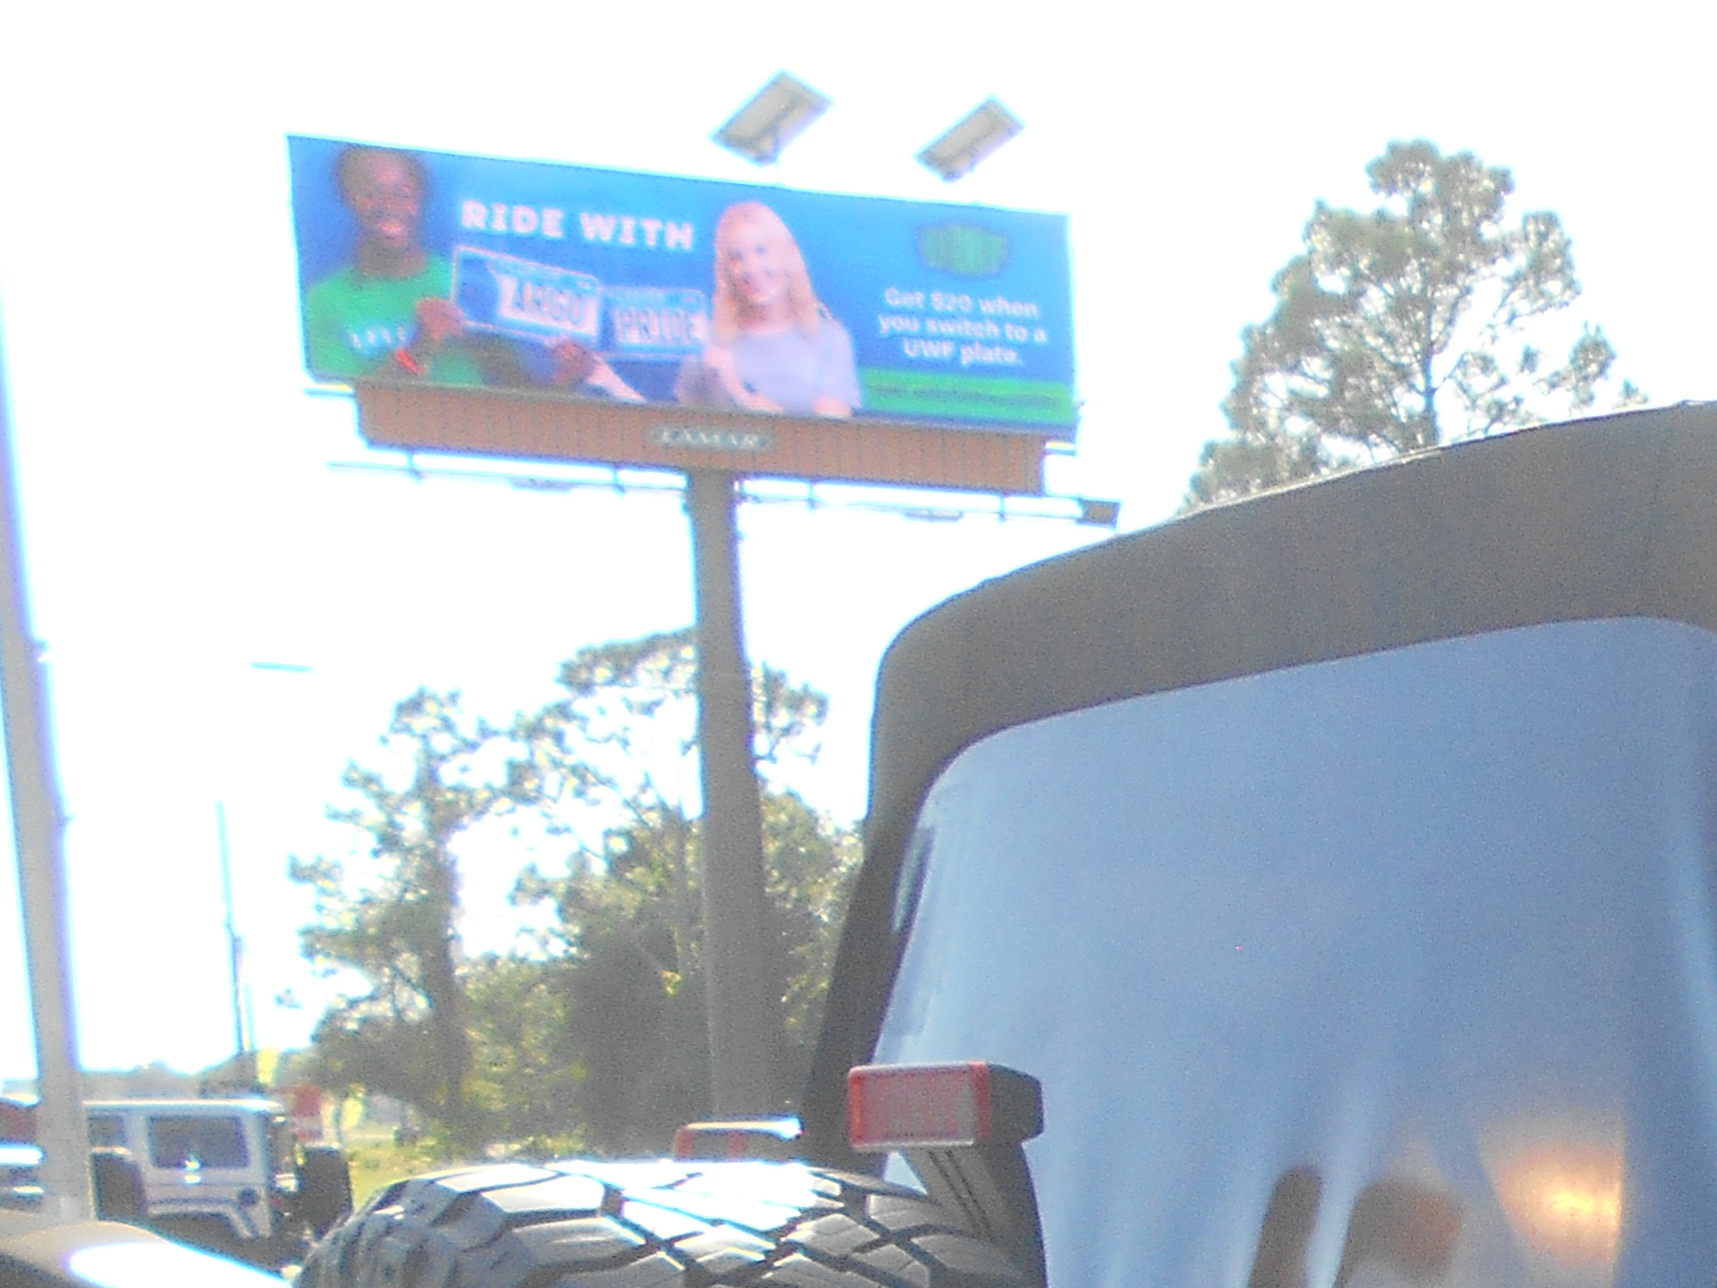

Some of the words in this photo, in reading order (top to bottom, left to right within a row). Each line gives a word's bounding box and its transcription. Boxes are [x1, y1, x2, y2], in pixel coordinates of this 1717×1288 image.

[462, 200, 563, 238] RIDE
[579, 212, 694, 250] WITH
[884, 287, 924, 309] Get
[930, 291, 972, 312] $20
[979, 296, 1039, 318] when
[879, 315, 919, 335] you
[927, 318, 999, 338] switch
[1005, 323, 1029, 342] to
[1034, 328, 1048, 343] a
[961, 341, 1024, 367] plate.
